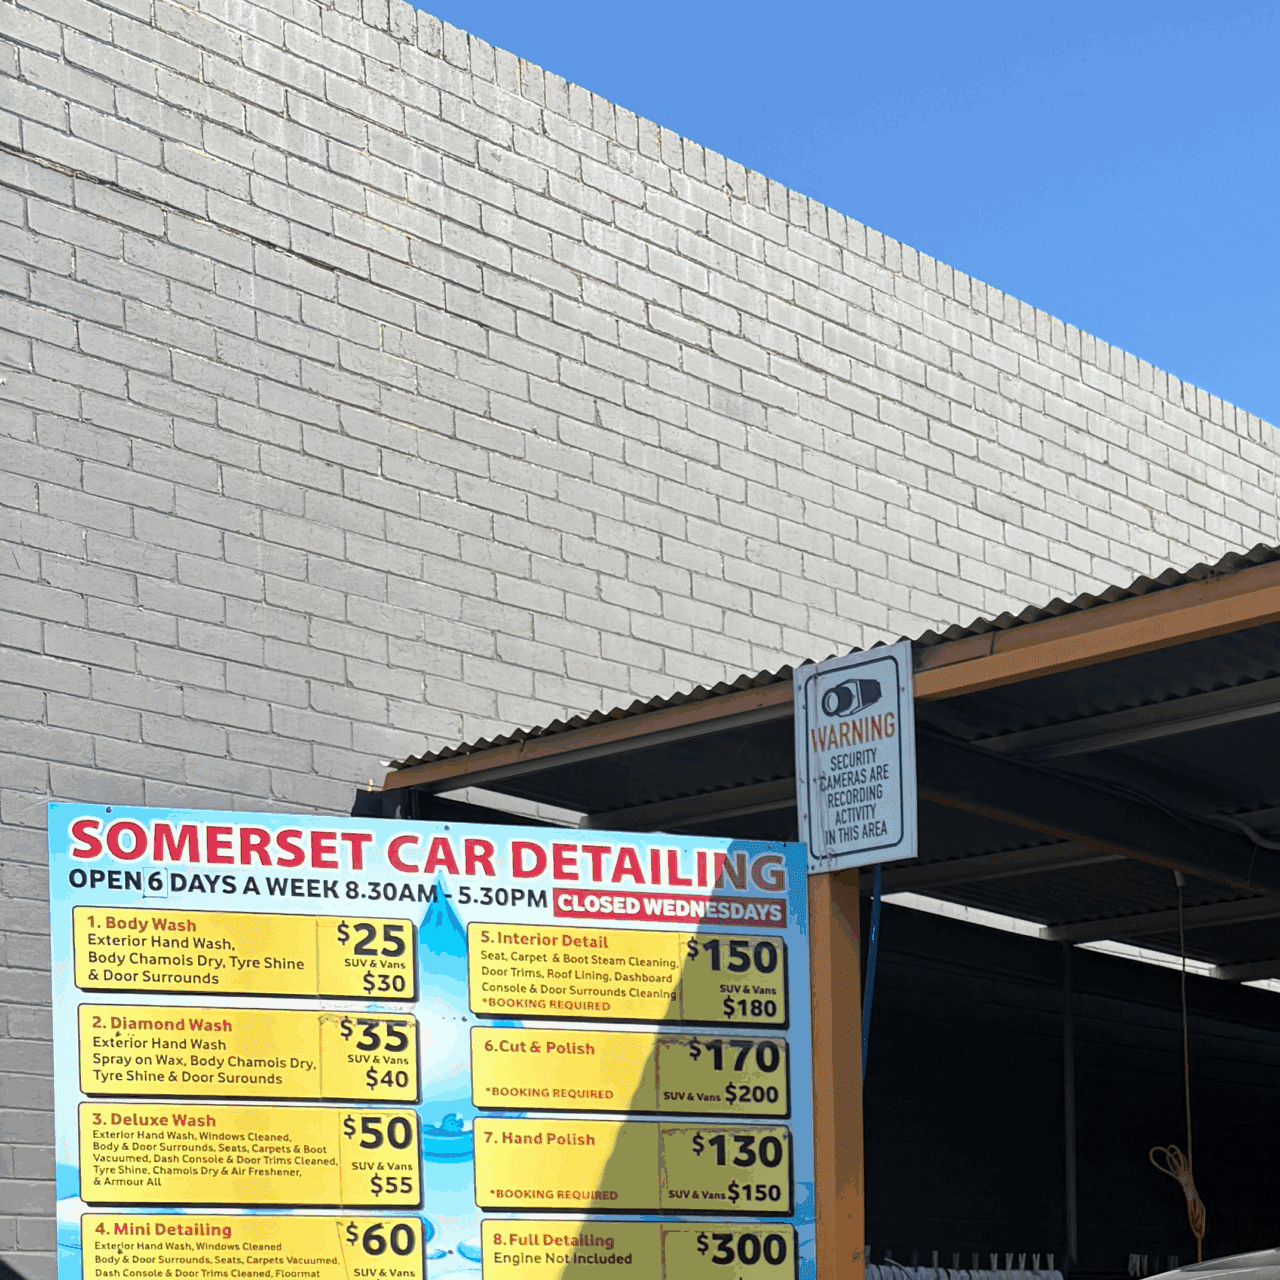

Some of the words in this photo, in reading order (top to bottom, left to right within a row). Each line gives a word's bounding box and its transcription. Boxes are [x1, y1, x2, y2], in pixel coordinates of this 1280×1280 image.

[811, 712, 896, 753] WARNING
[831, 748, 877, 771] SECURITY
[820, 769, 866, 792] CAMERAS
[869, 764, 889, 781] ARE
[828, 784, 883, 808] RECORDING
[835, 804, 876, 825] ACTIVITY
[826, 830, 835, 845] IN
[838, 826, 859, 843] THIS
[862, 821, 887, 838] AREA
[71, 820, 372, 870] SOMERSET
[388, 835, 496, 876] CAR
[512, 841, 786, 891] DETAILING
[69, 869, 141, 890] OPEN
[148, 871, 163, 891] 6
[171, 873, 236, 894] DAYS
[243, 876, 260, 895] A
[266, 877, 339, 898] WEEK
[346, 880, 438, 902] 8.30AM
[458, 886, 547, 908] 5.30PM
[558, 894, 640, 915] CLOSED
[643, 898, 782, 921] WEDNESDAYS
[87, 916, 100, 928] 1.
[106, 916, 148, 933] Body
[152, 918, 196, 932] Wash
[88, 934, 147, 946] Exterior
[152, 936, 188, 948] Hand
[193, 937, 235, 951] Wash,
[338, 920, 405, 957] $25
[481, 931, 494, 943] 5.
[498, 932, 558, 946] Interior
[562, 934, 608, 948] Detail
[89, 951, 125, 966] Body
[130, 953, 193, 966] Chamois
[198, 955, 225, 969] Dry,
[229, 956, 260, 970] Tyre
[264, 957, 304, 969] Shine
[345, 959, 367, 967] SUV
[380, 960, 405, 969] Vans
[687, 936, 777, 973] $150
[89, 969, 99, 980] &
[104, 970, 138, 981] Door
[143, 971, 219, 984] Surrounds
[363, 970, 405, 994] $30
[720, 984, 741, 993] SUV
[743, 985, 750, 994] &
[752, 986, 776, 995] Vans
[550, 1000, 610, 1010] REQUIRED
[724, 995, 776, 1019] $180
[93, 1016, 106, 1028] 2.
[111, 1017, 185, 1030] Diamond
[189, 1019, 232, 1031] Wash
[93, 1037, 148, 1048] Exterior
[152, 1038, 186, 1049] Hand
[191, 1039, 226, 1050] Wash
[341, 1016, 408, 1052] $35
[530, 1041, 541, 1053] &
[547, 1041, 594, 1054] Polish
[689, 1037, 780, 1073] $170
[93, 1053, 131, 1067] Spray
[135, 1057, 152, 1065] on
[156, 1055, 186, 1066] Wax,
[191, 1055, 224, 1069] Body
[228, 1056, 286, 1068] Chamois
[290, 1058, 316, 1071] Dry,
[348, 1055, 370, 1063] SUV
[383, 1056, 409, 1064] Vans
[93, 1070, 122, 1083] Tyre
[127, 1070, 164, 1081] Shine
[168, 1071, 177, 1081] &
[182, 1071, 214, 1082] Door
[218, 1072, 282, 1084] Surounds
[366, 1066, 408, 1090] $40
[553, 1089, 613, 1098] REQUIRED
[664, 1092, 685, 1100] SUV
[687, 1093, 694, 1101] &
[696, 1093, 721, 1102] Vans
[725, 1081, 778, 1105] $200
[93, 1113, 106, 1125] 3.
[111, 1113, 168, 1126] Deluxe
[172, 1114, 215, 1127] Wash
[93, 1130, 134, 1139] Exterior
[138, 1131, 164, 1139] Hand
[167, 1131, 197, 1140] Wash,
[199, 1132, 245, 1141] Windows
[248, 1133, 291, 1142] Cleaned,
[344, 1114, 412, 1149] $50
[484, 1131, 498, 1143] 7.
[502, 1132, 542, 1144] Hand
[547, 1133, 594, 1145] Polish
[693, 1131, 782, 1168] $130
[352, 1162, 374, 1170] SUV
[377, 1162, 384, 1170] &
[387, 1162, 413, 1171] Vans
[371, 1173, 412, 1197] $55
[669, 1190, 690, 1199] SUV
[692, 1191, 699, 1199] &
[701, 1191, 726, 1200] Vans
[728, 1180, 781, 1204] $150
[557, 1190, 618, 1200] REQUIRED
[95, 1223, 109, 1235] 4.
[114, 1223, 150, 1235] Mini
[155, 1223, 231, 1239] Detailing
[346, 1221, 415, 1256] $60
[95, 1241, 134, 1252] Exterior
[137, 1242, 163, 1250] Hand
[165, 1242, 194, 1251] Wash,
[196, 1242, 240, 1250] Windows
[494, 1233, 506, 1245] 8.
[510, 1234, 539, 1245] Full
[543, 1234, 614, 1250] Detailing
[697, 1231, 786, 1265] $300
[494, 1252, 541, 1266] Engine
[546, 1253, 570, 1263] Not
[574, 1253, 632, 1264] Included
